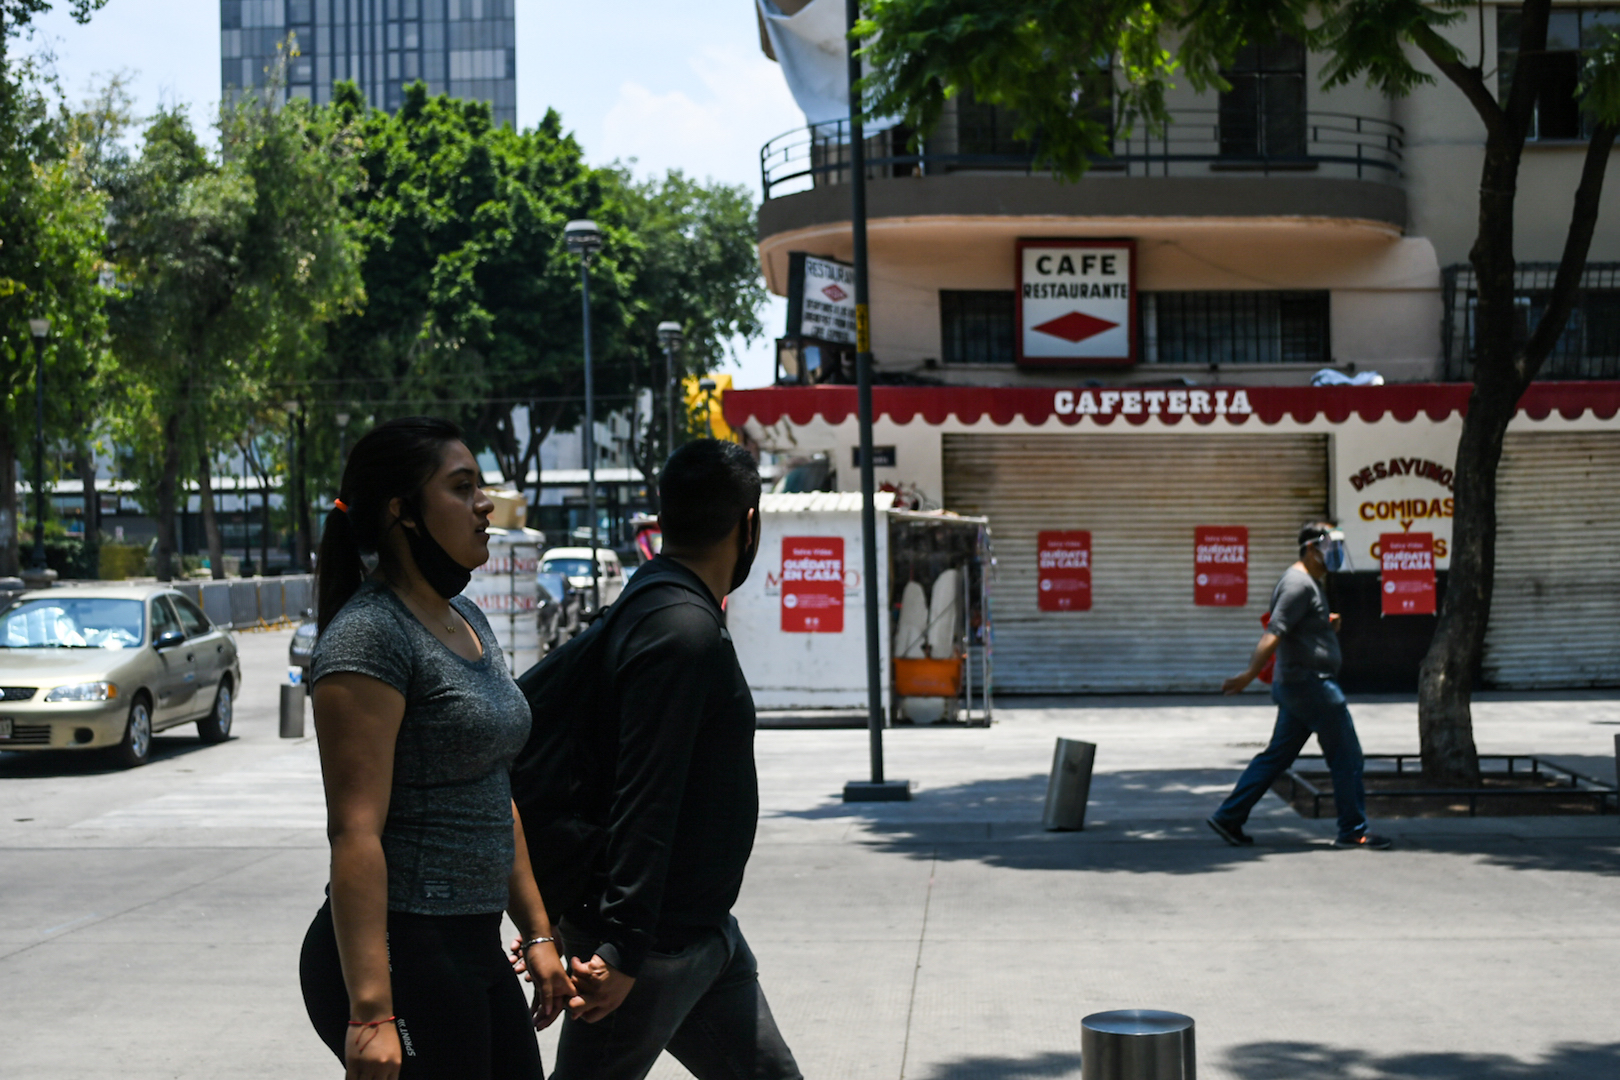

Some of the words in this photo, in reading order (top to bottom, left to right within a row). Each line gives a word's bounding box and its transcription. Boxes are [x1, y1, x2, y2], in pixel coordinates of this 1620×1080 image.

[1036, 255, 1116, 276] CAFE
[1023, 283, 1127, 299] RESTAURANTE
[1054, 390, 1252, 414] CAFETERIA
[784, 570, 802, 581] EN
[804, 570, 841, 581] CASA
[400, 1028, 416, 1057] SPRINT
